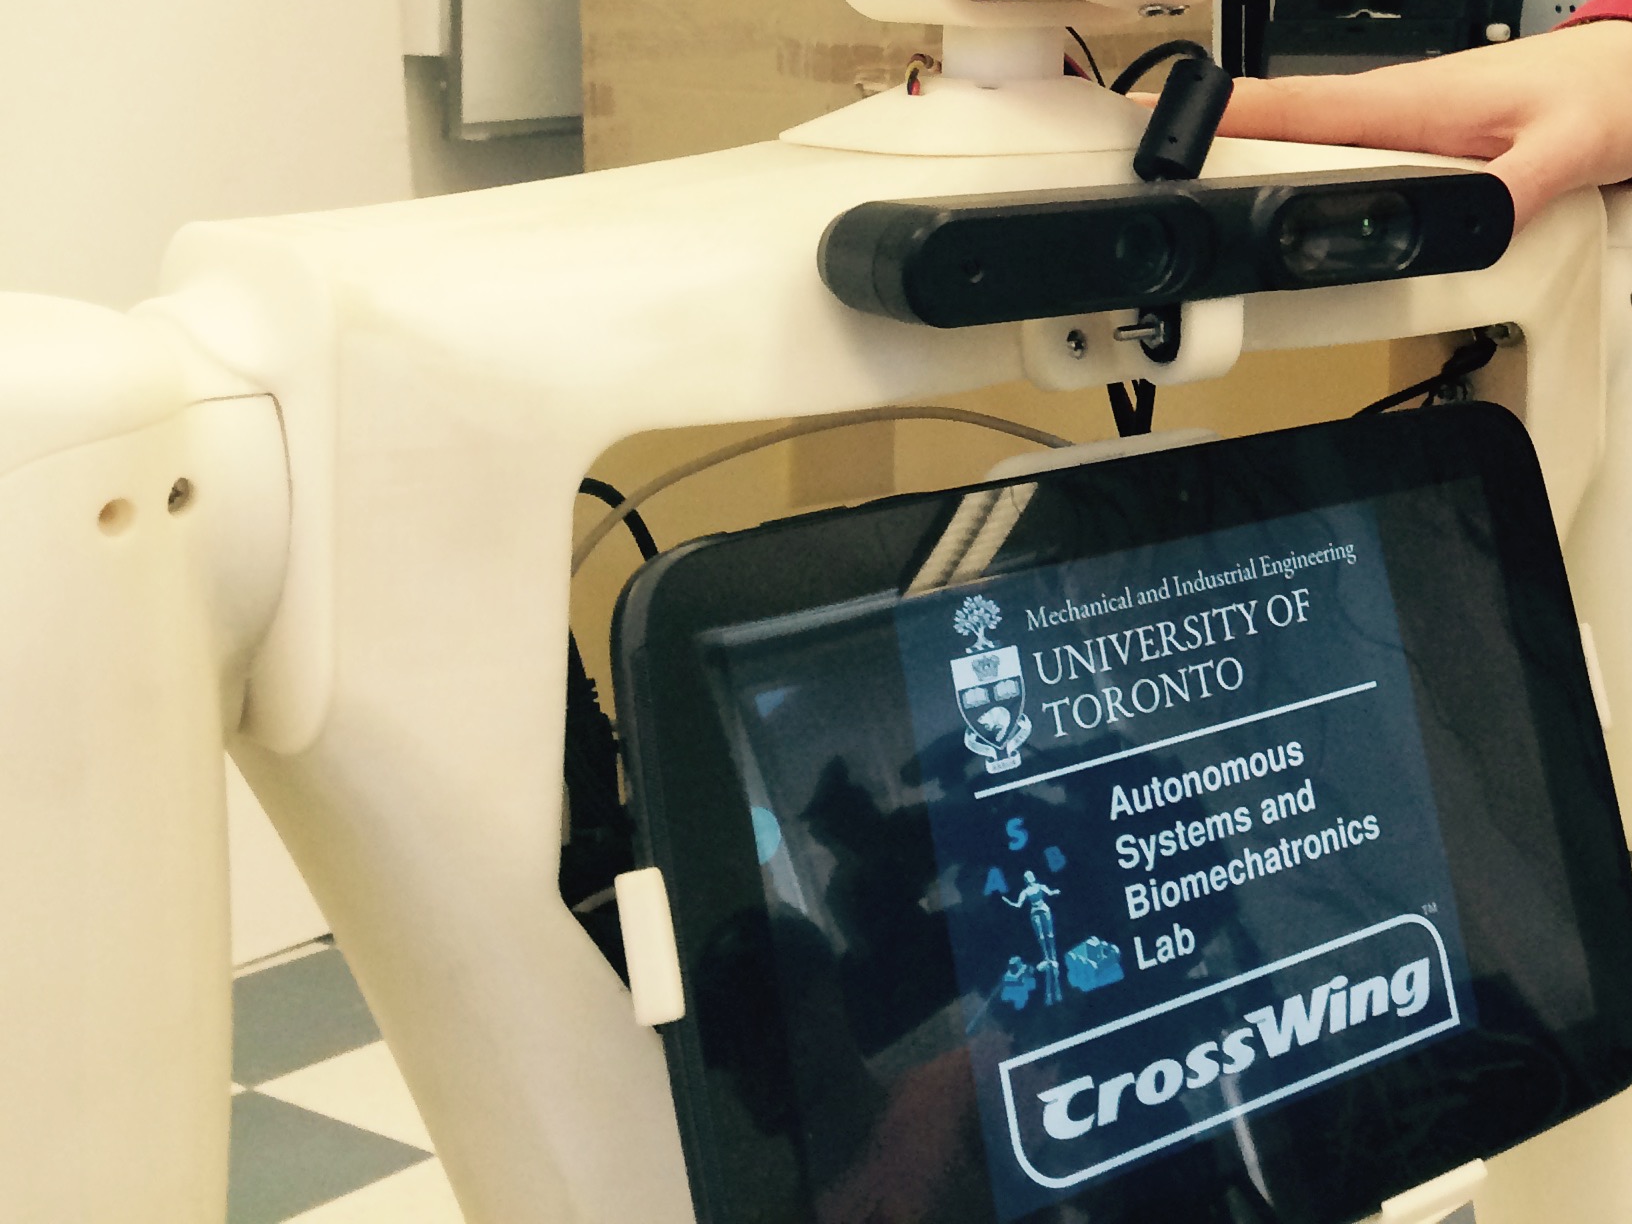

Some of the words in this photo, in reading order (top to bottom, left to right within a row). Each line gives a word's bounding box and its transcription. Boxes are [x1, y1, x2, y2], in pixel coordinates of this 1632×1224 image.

[1025, 587, 1132, 631] Mechanical
[1137, 578, 1171, 604] and
[1174, 559, 1258, 597] Industrial
[1261, 541, 1357, 575] Engineering
[1033, 599, 1259, 685] UNIVERSITY
[1266, 588, 1311, 627] OF
[1042, 657, 1244, 738] TORONTO
[1110, 741, 1304, 820] Autonomous
[1005, 817, 1028, 851] S
[1116, 804, 1251, 872] Systems
[1261, 779, 1316, 826] and
[1125, 811, 1380, 919] Biomechatronics
[983, 867, 1009, 896] A
[1134, 923, 1195, 970] Lab
[1037, 957, 1430, 1140] CrossWing
